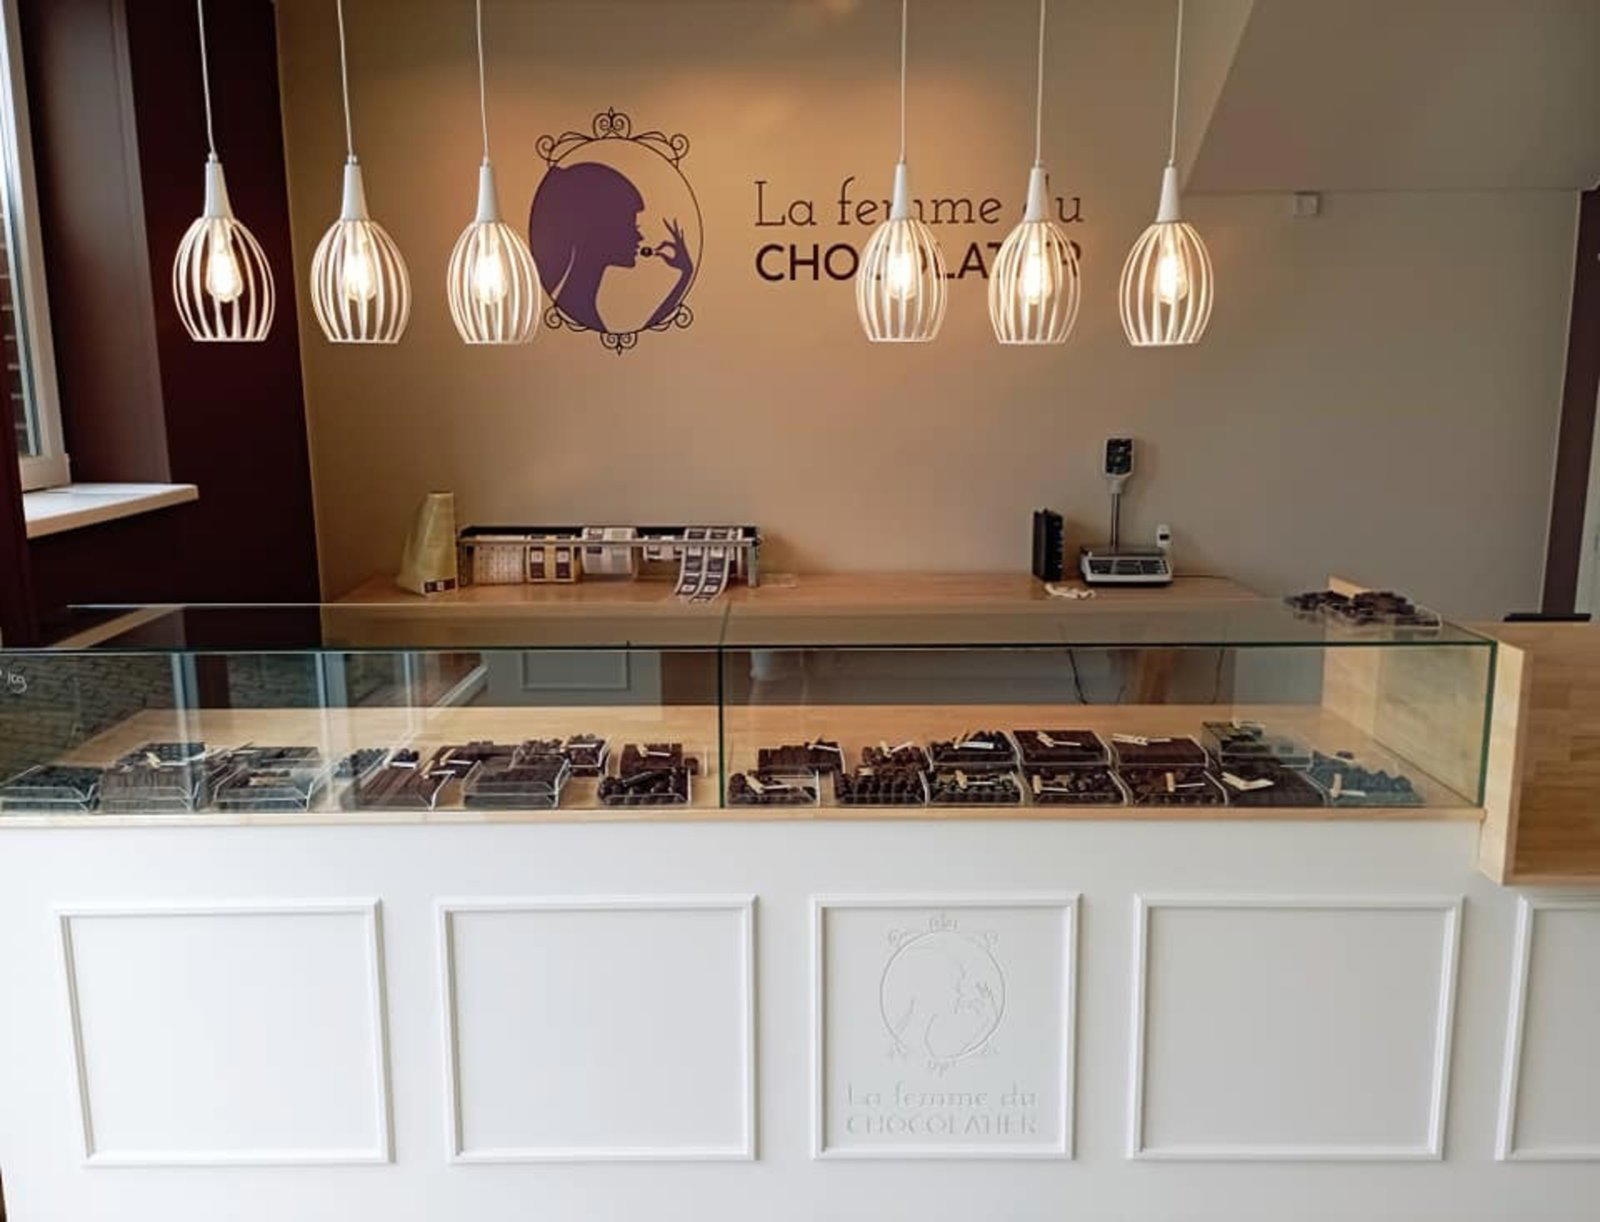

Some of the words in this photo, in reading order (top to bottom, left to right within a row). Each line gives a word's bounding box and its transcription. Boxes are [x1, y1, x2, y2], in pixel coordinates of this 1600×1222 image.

[754, 180, 817, 226] La
[1022, 173, 1084, 223] u
[895, 1080, 989, 1108] femme
[1000, 1080, 1038, 1107] du
[846, 1112, 1037, 1135] CHOCOLATIER
